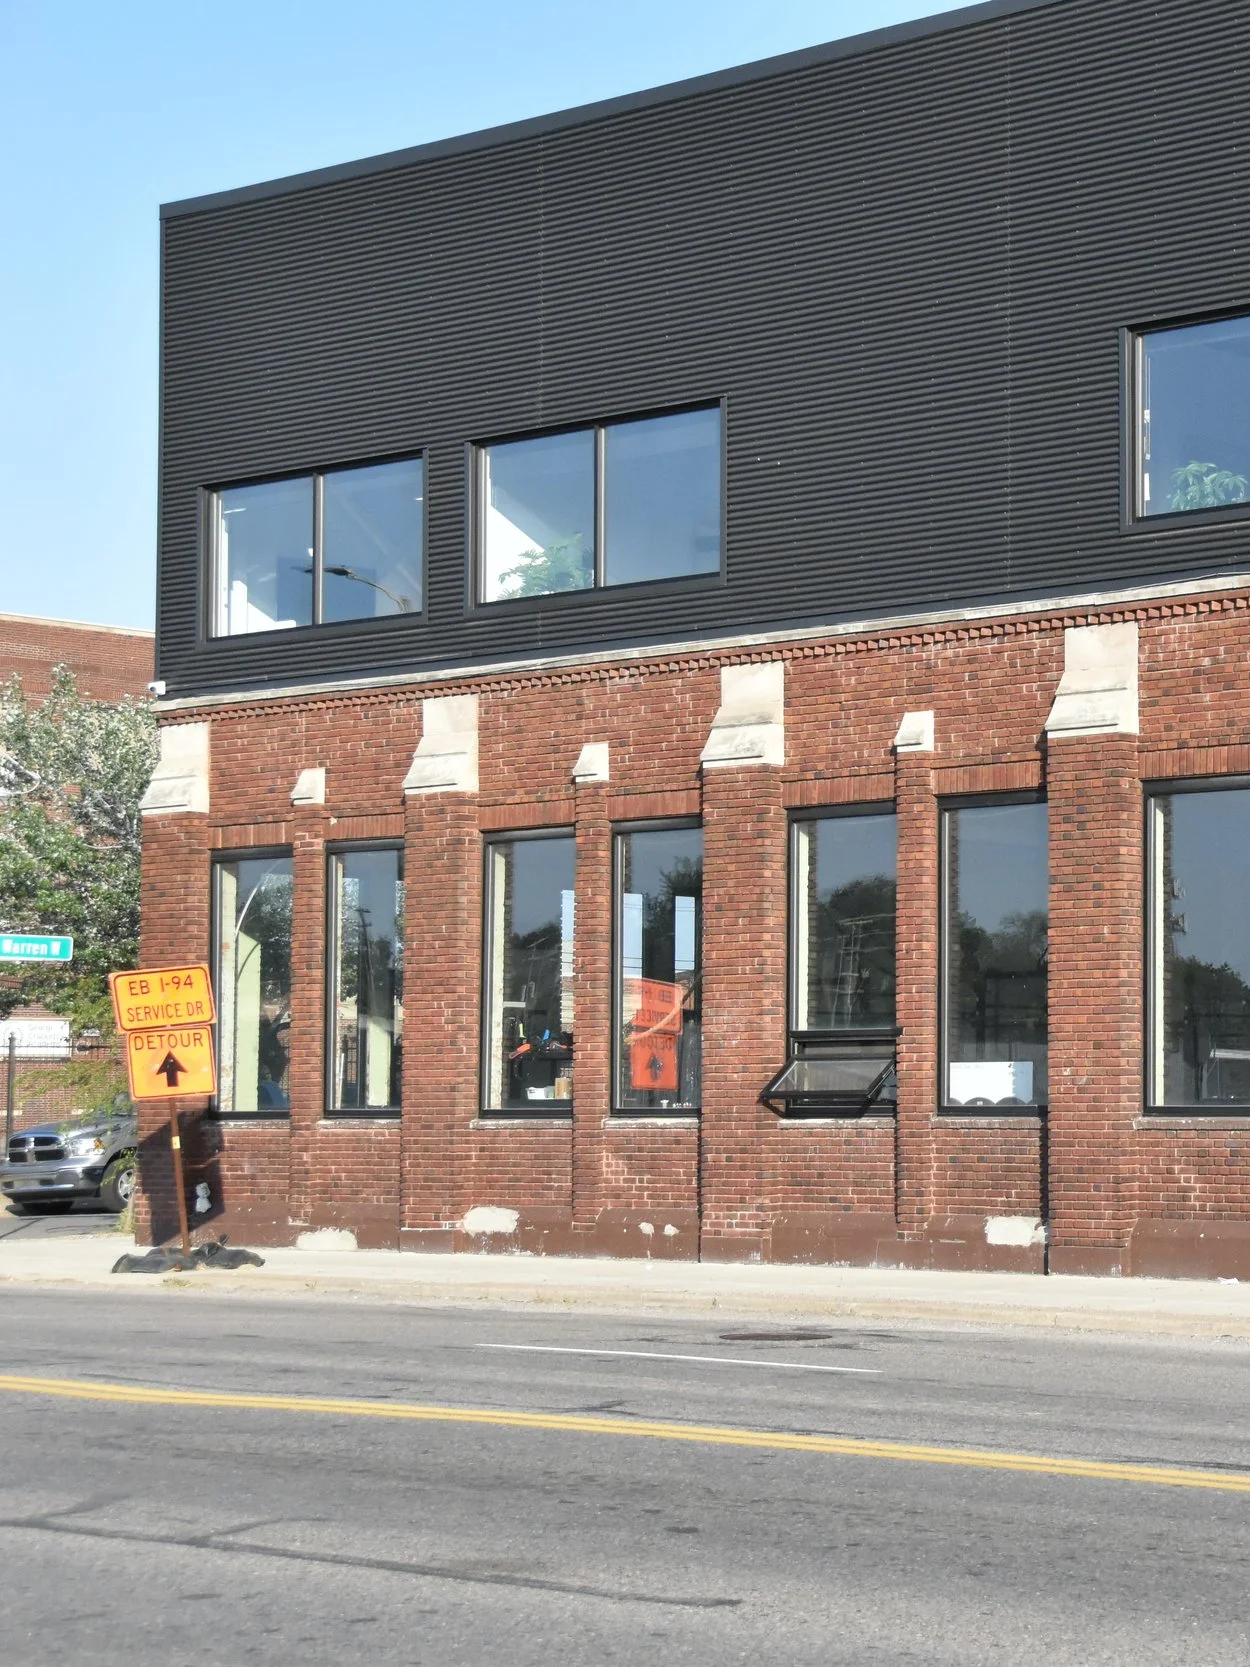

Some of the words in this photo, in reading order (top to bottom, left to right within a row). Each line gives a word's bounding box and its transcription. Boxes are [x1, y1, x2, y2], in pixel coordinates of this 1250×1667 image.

[2, 939, 48, 955] Warren
[51, 940, 61, 956] W
[128, 980, 151, 996] EB
[160, 974, 194, 993] I-94
[127, 1003, 185, 1023] SERVICE
[186, 1001, 205, 1017] DR
[134, 1032, 204, 1051] DETOUR
